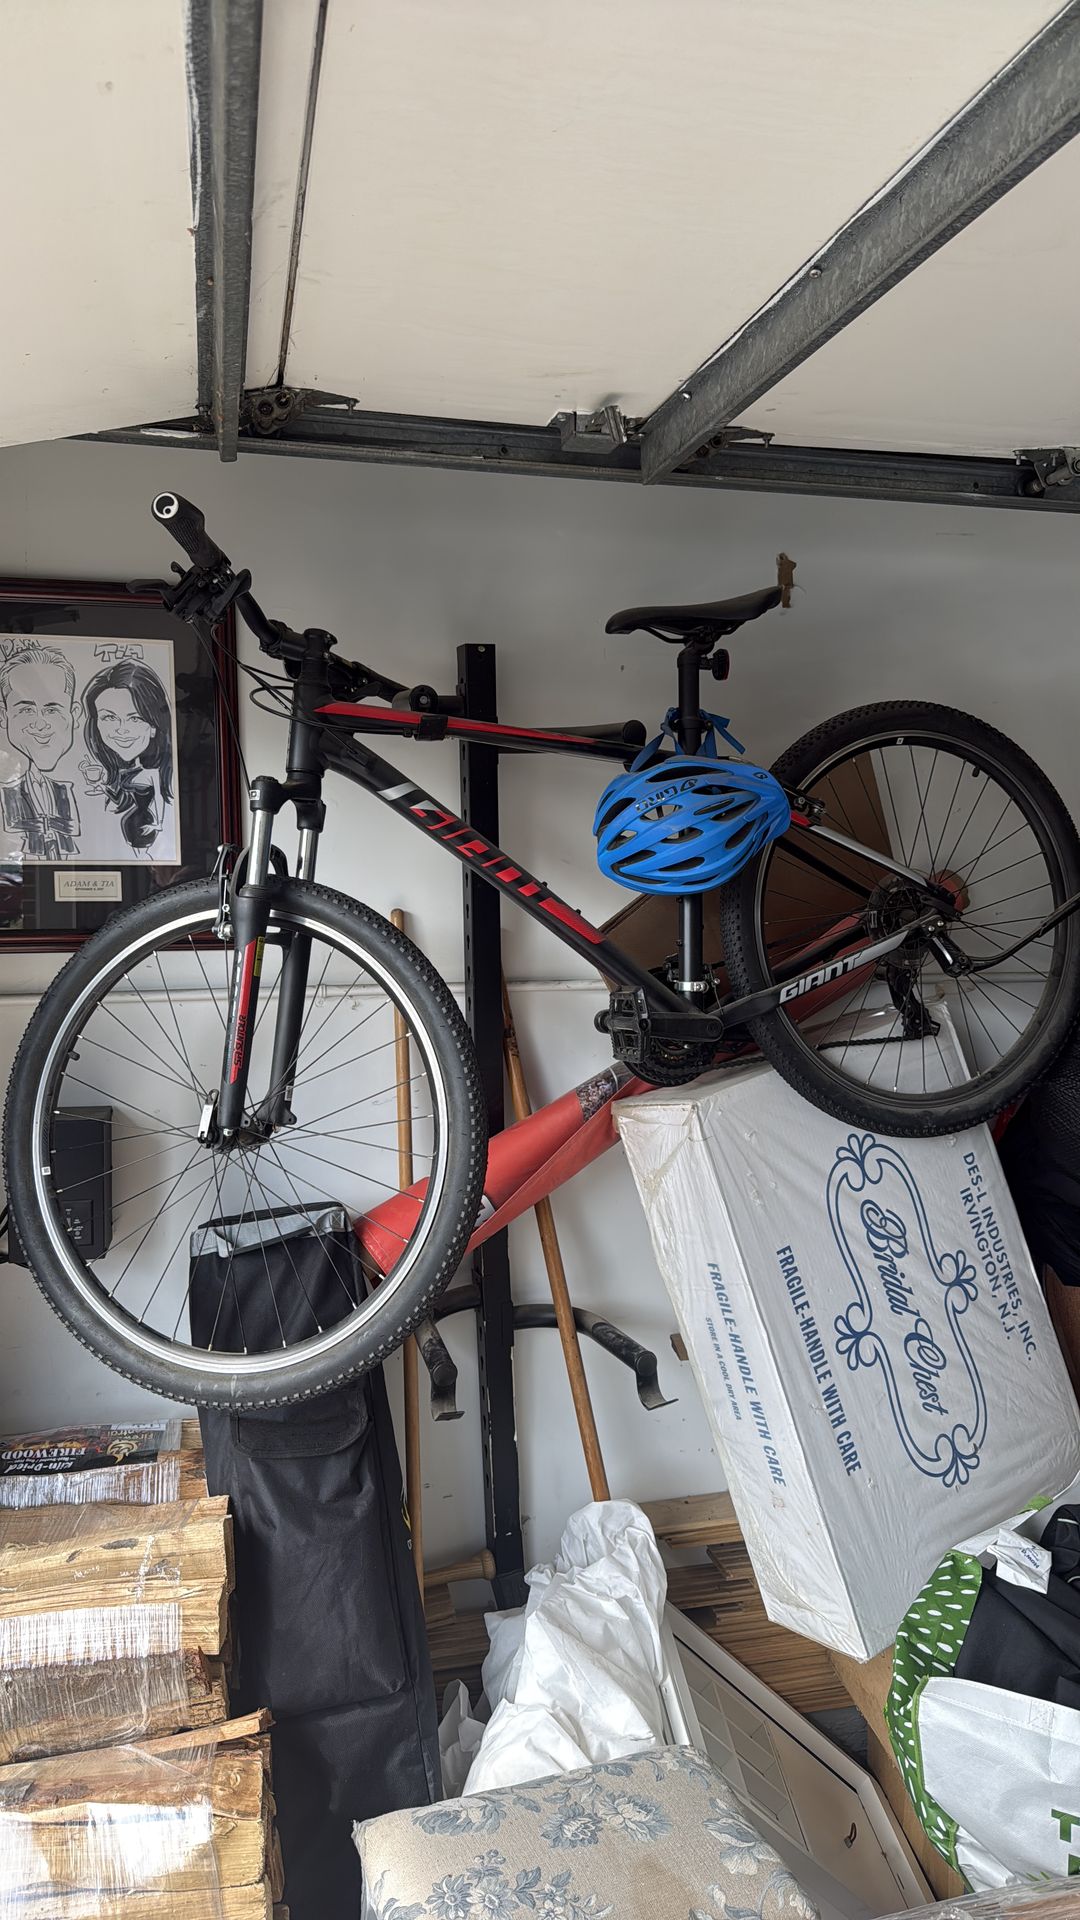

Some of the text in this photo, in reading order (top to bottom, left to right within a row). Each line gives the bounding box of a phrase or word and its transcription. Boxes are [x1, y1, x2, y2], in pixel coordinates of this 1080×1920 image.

[63, 880, 91, 888] ADAM
[779, 951, 863, 1005] GIANT
[960, 1187, 1016, 1341] IRVINGTON, N.J.
[963, 1152, 1036, 1361] DES-L INDUSTRIES, INC.
[860, 1199, 949, 1416] Bridal Chest
[705, 1317, 719, 1342] STORE
[713, 1343, 721, 1352] IN
[718, 1361, 730, 1381] COOL
[776, 1245, 862, 1477] FRAGILE-HANDLE WITH CARE
[707, 1262, 787, 1487] FRAGILE-HANDLE WITH CARE
[725, 1383, 736, 1399] DRY
[730, 1400, 742, 1420] AREA
[1, 1447, 87, 1460] FIREWOOD
[3, 1461, 74, 1474] Kiln-Dried
